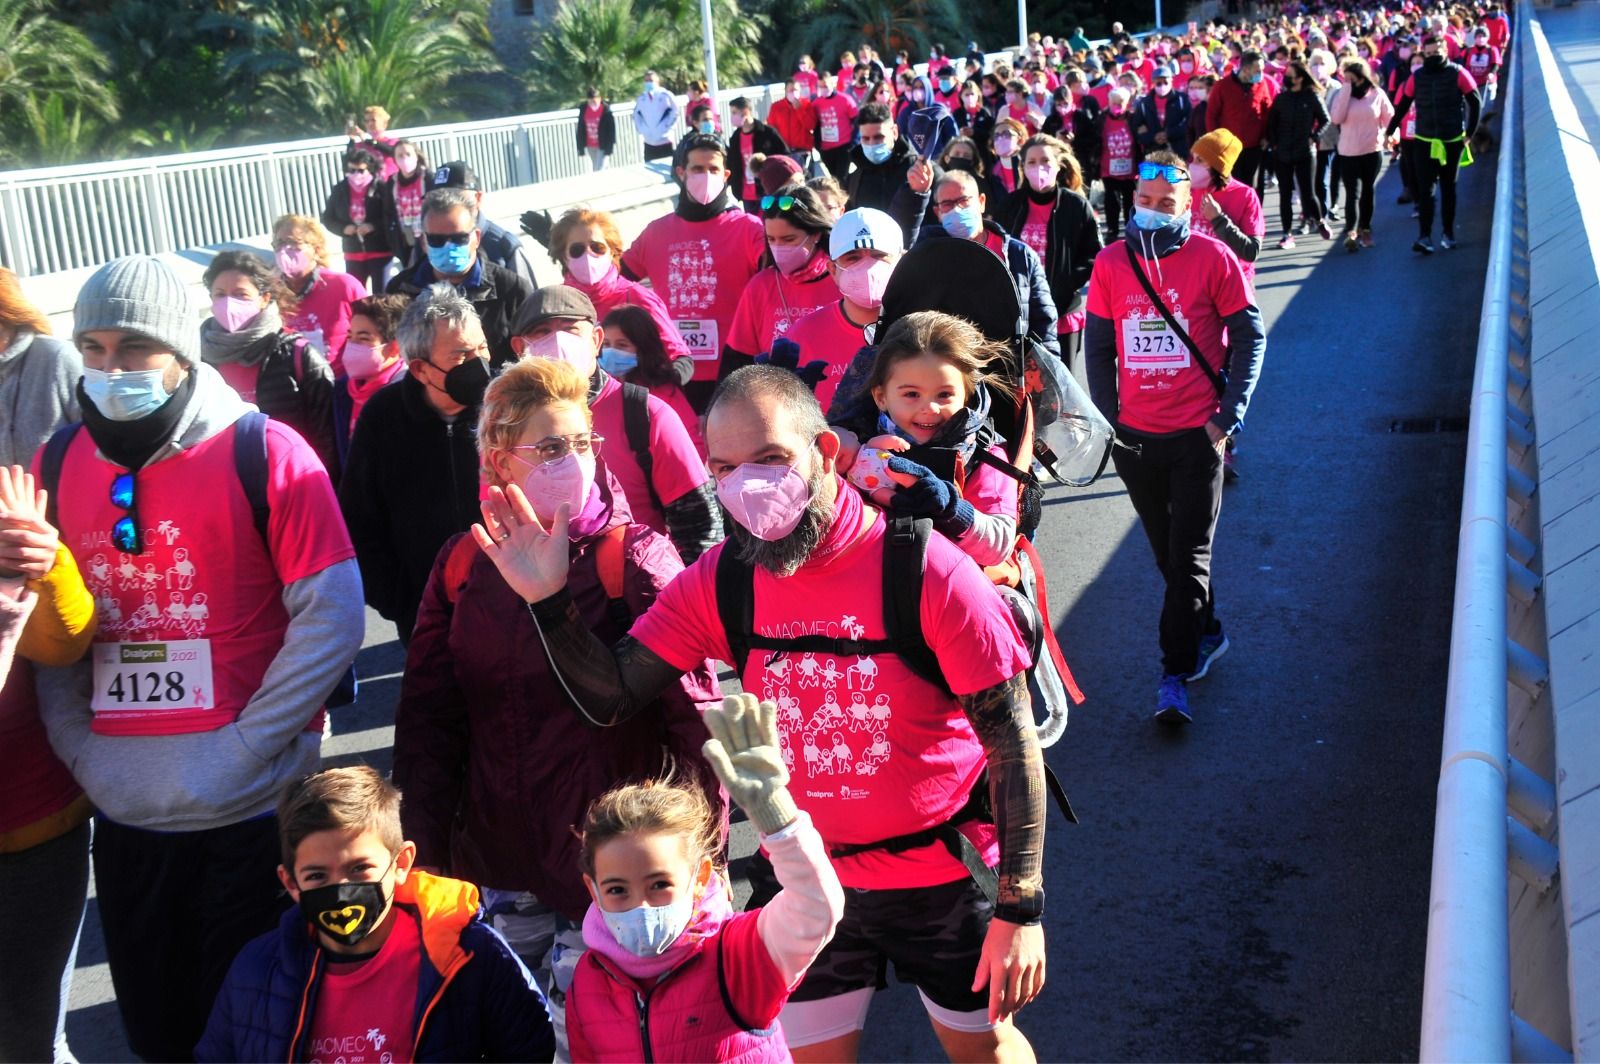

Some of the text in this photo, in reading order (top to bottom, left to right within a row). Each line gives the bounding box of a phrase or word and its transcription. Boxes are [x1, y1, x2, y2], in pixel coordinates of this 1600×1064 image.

[1133, 336, 1175, 353] 3273
[171, 651, 198, 661] 2021
[107, 671, 185, 702] 4128
